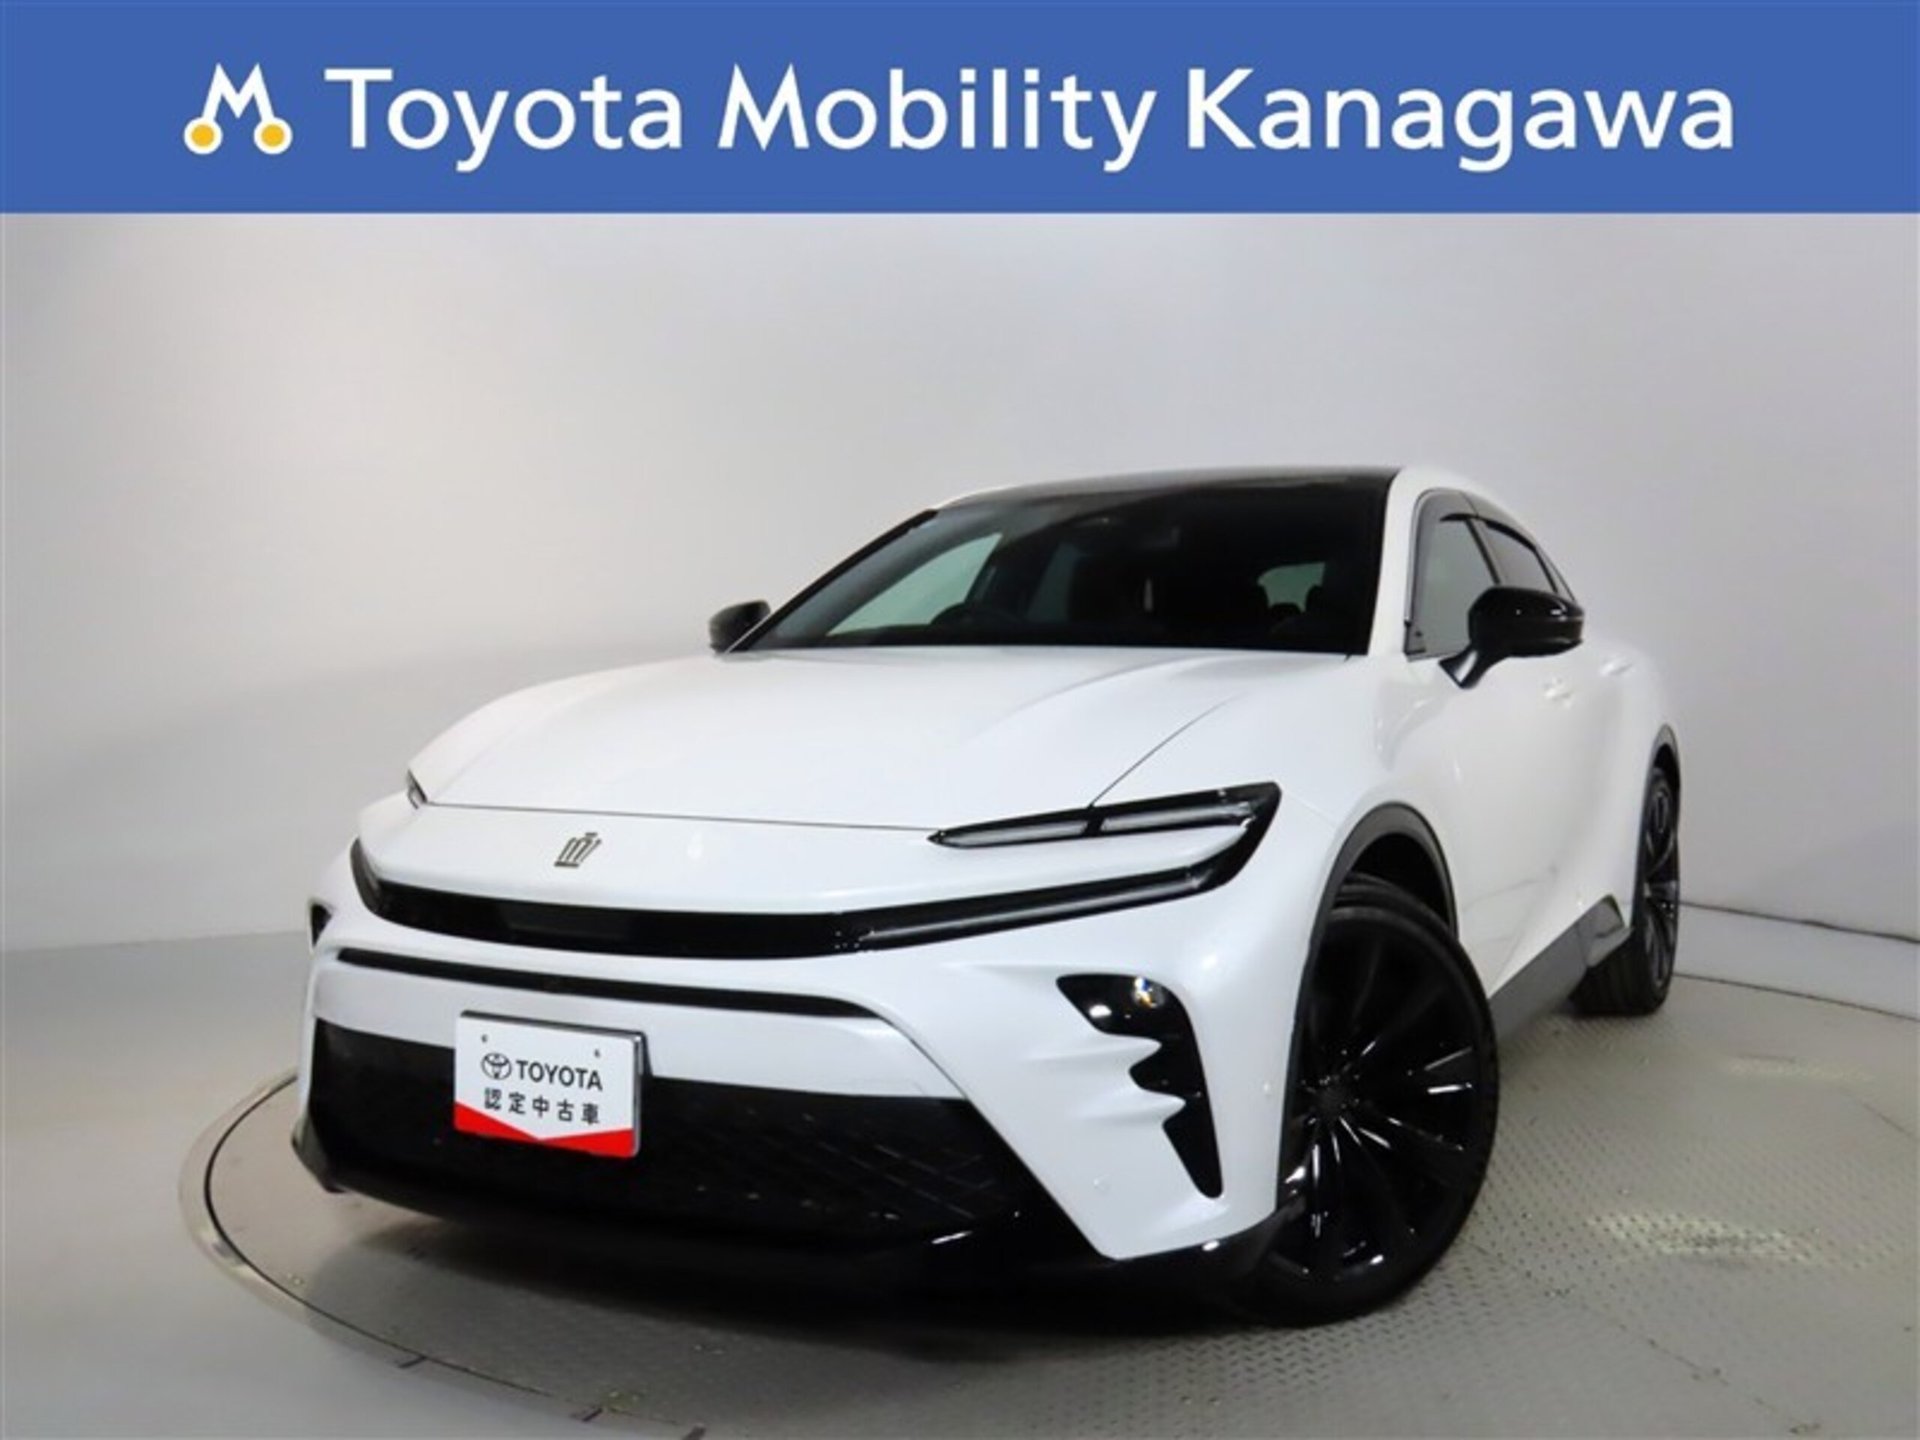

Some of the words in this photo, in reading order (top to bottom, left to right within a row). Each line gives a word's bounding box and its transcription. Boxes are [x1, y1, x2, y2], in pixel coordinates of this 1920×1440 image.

[515, 1059, 603, 1091] TOYOTA
[484, 1087, 600, 1125] 認定中古車
